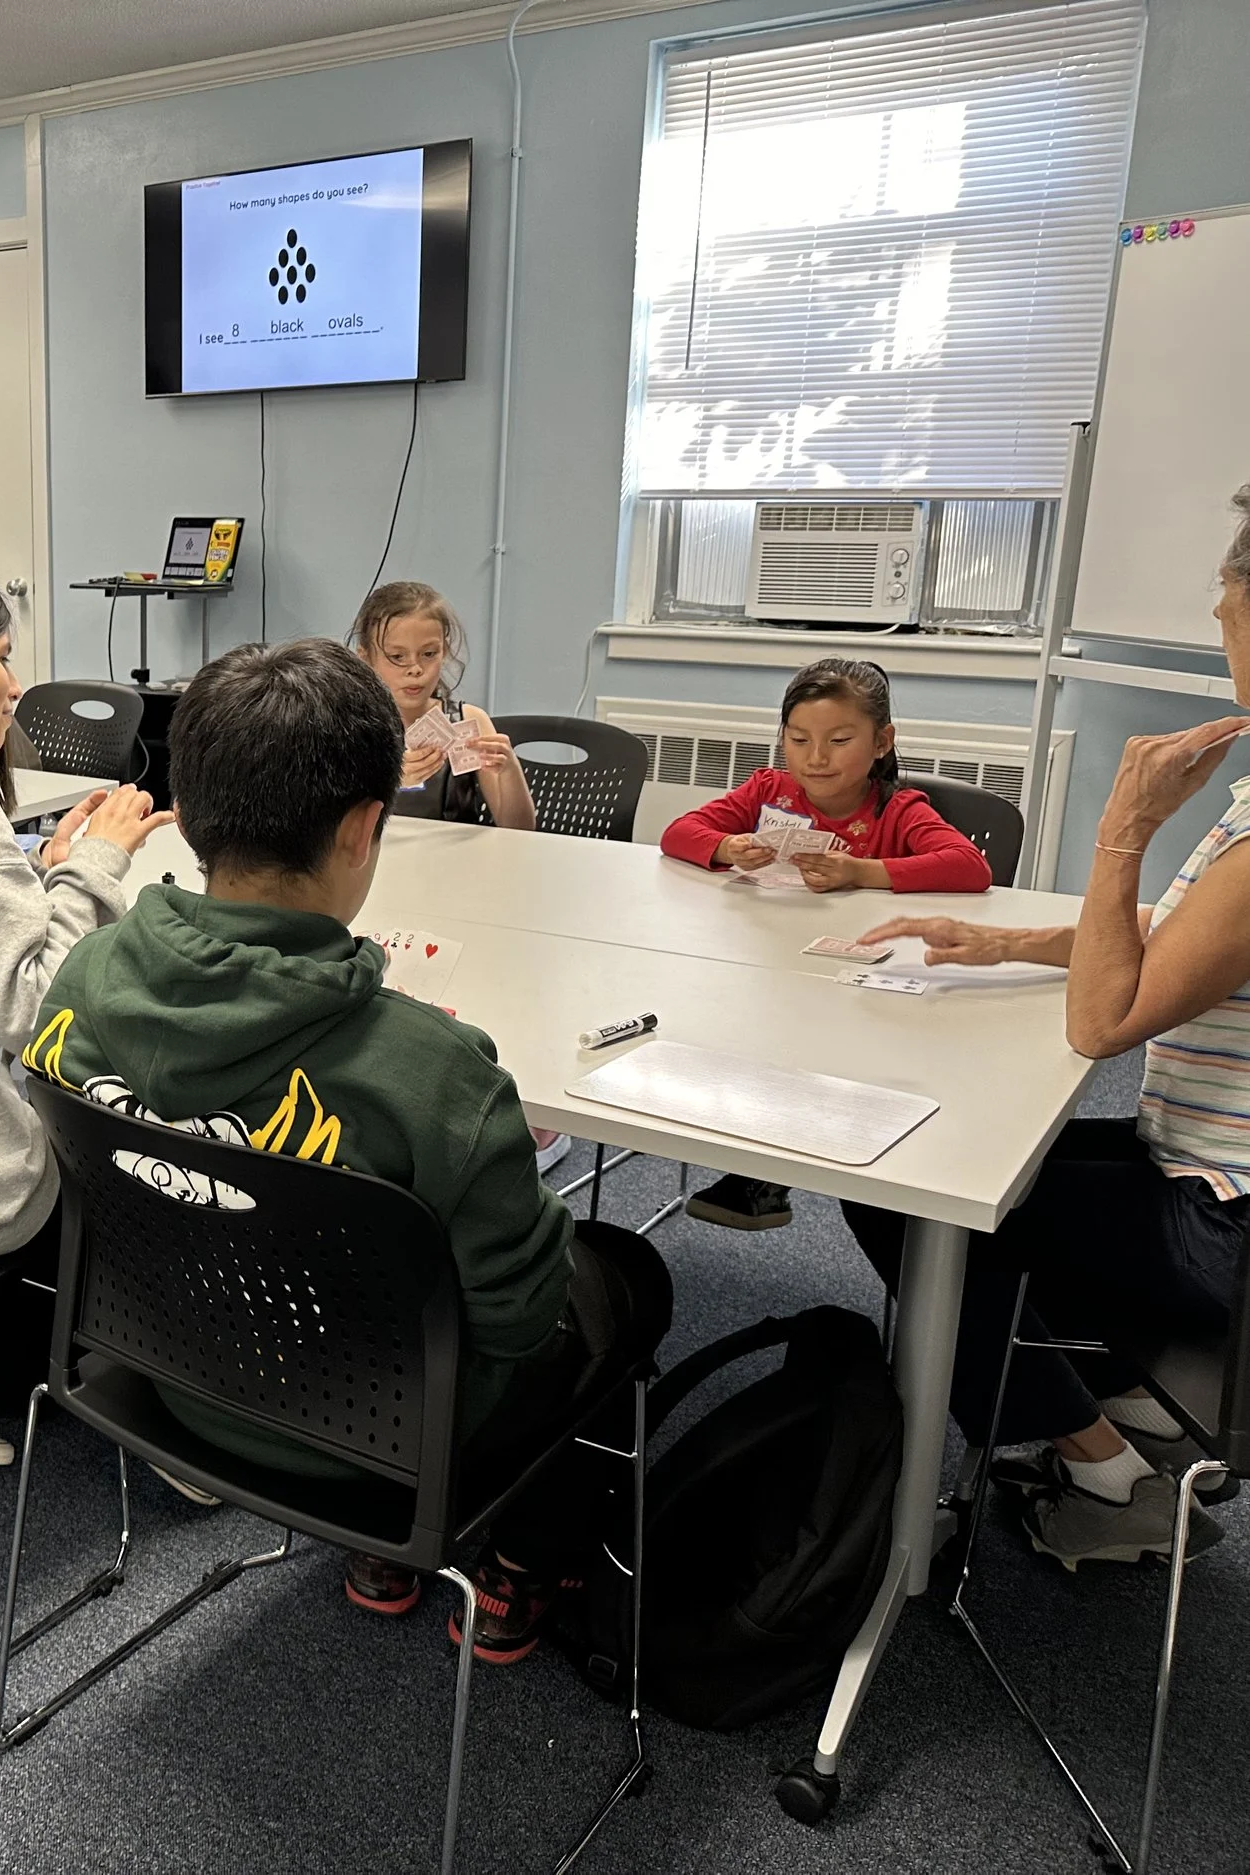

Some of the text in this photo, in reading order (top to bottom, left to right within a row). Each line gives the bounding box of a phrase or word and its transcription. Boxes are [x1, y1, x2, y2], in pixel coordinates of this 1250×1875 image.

[229, 183, 369, 211] How many shapes do you see?
[205, 333, 224, 344] see
[231, 323, 240, 337] 8
[270, 317, 305, 334] black
[328, 313, 364, 329] ovals
